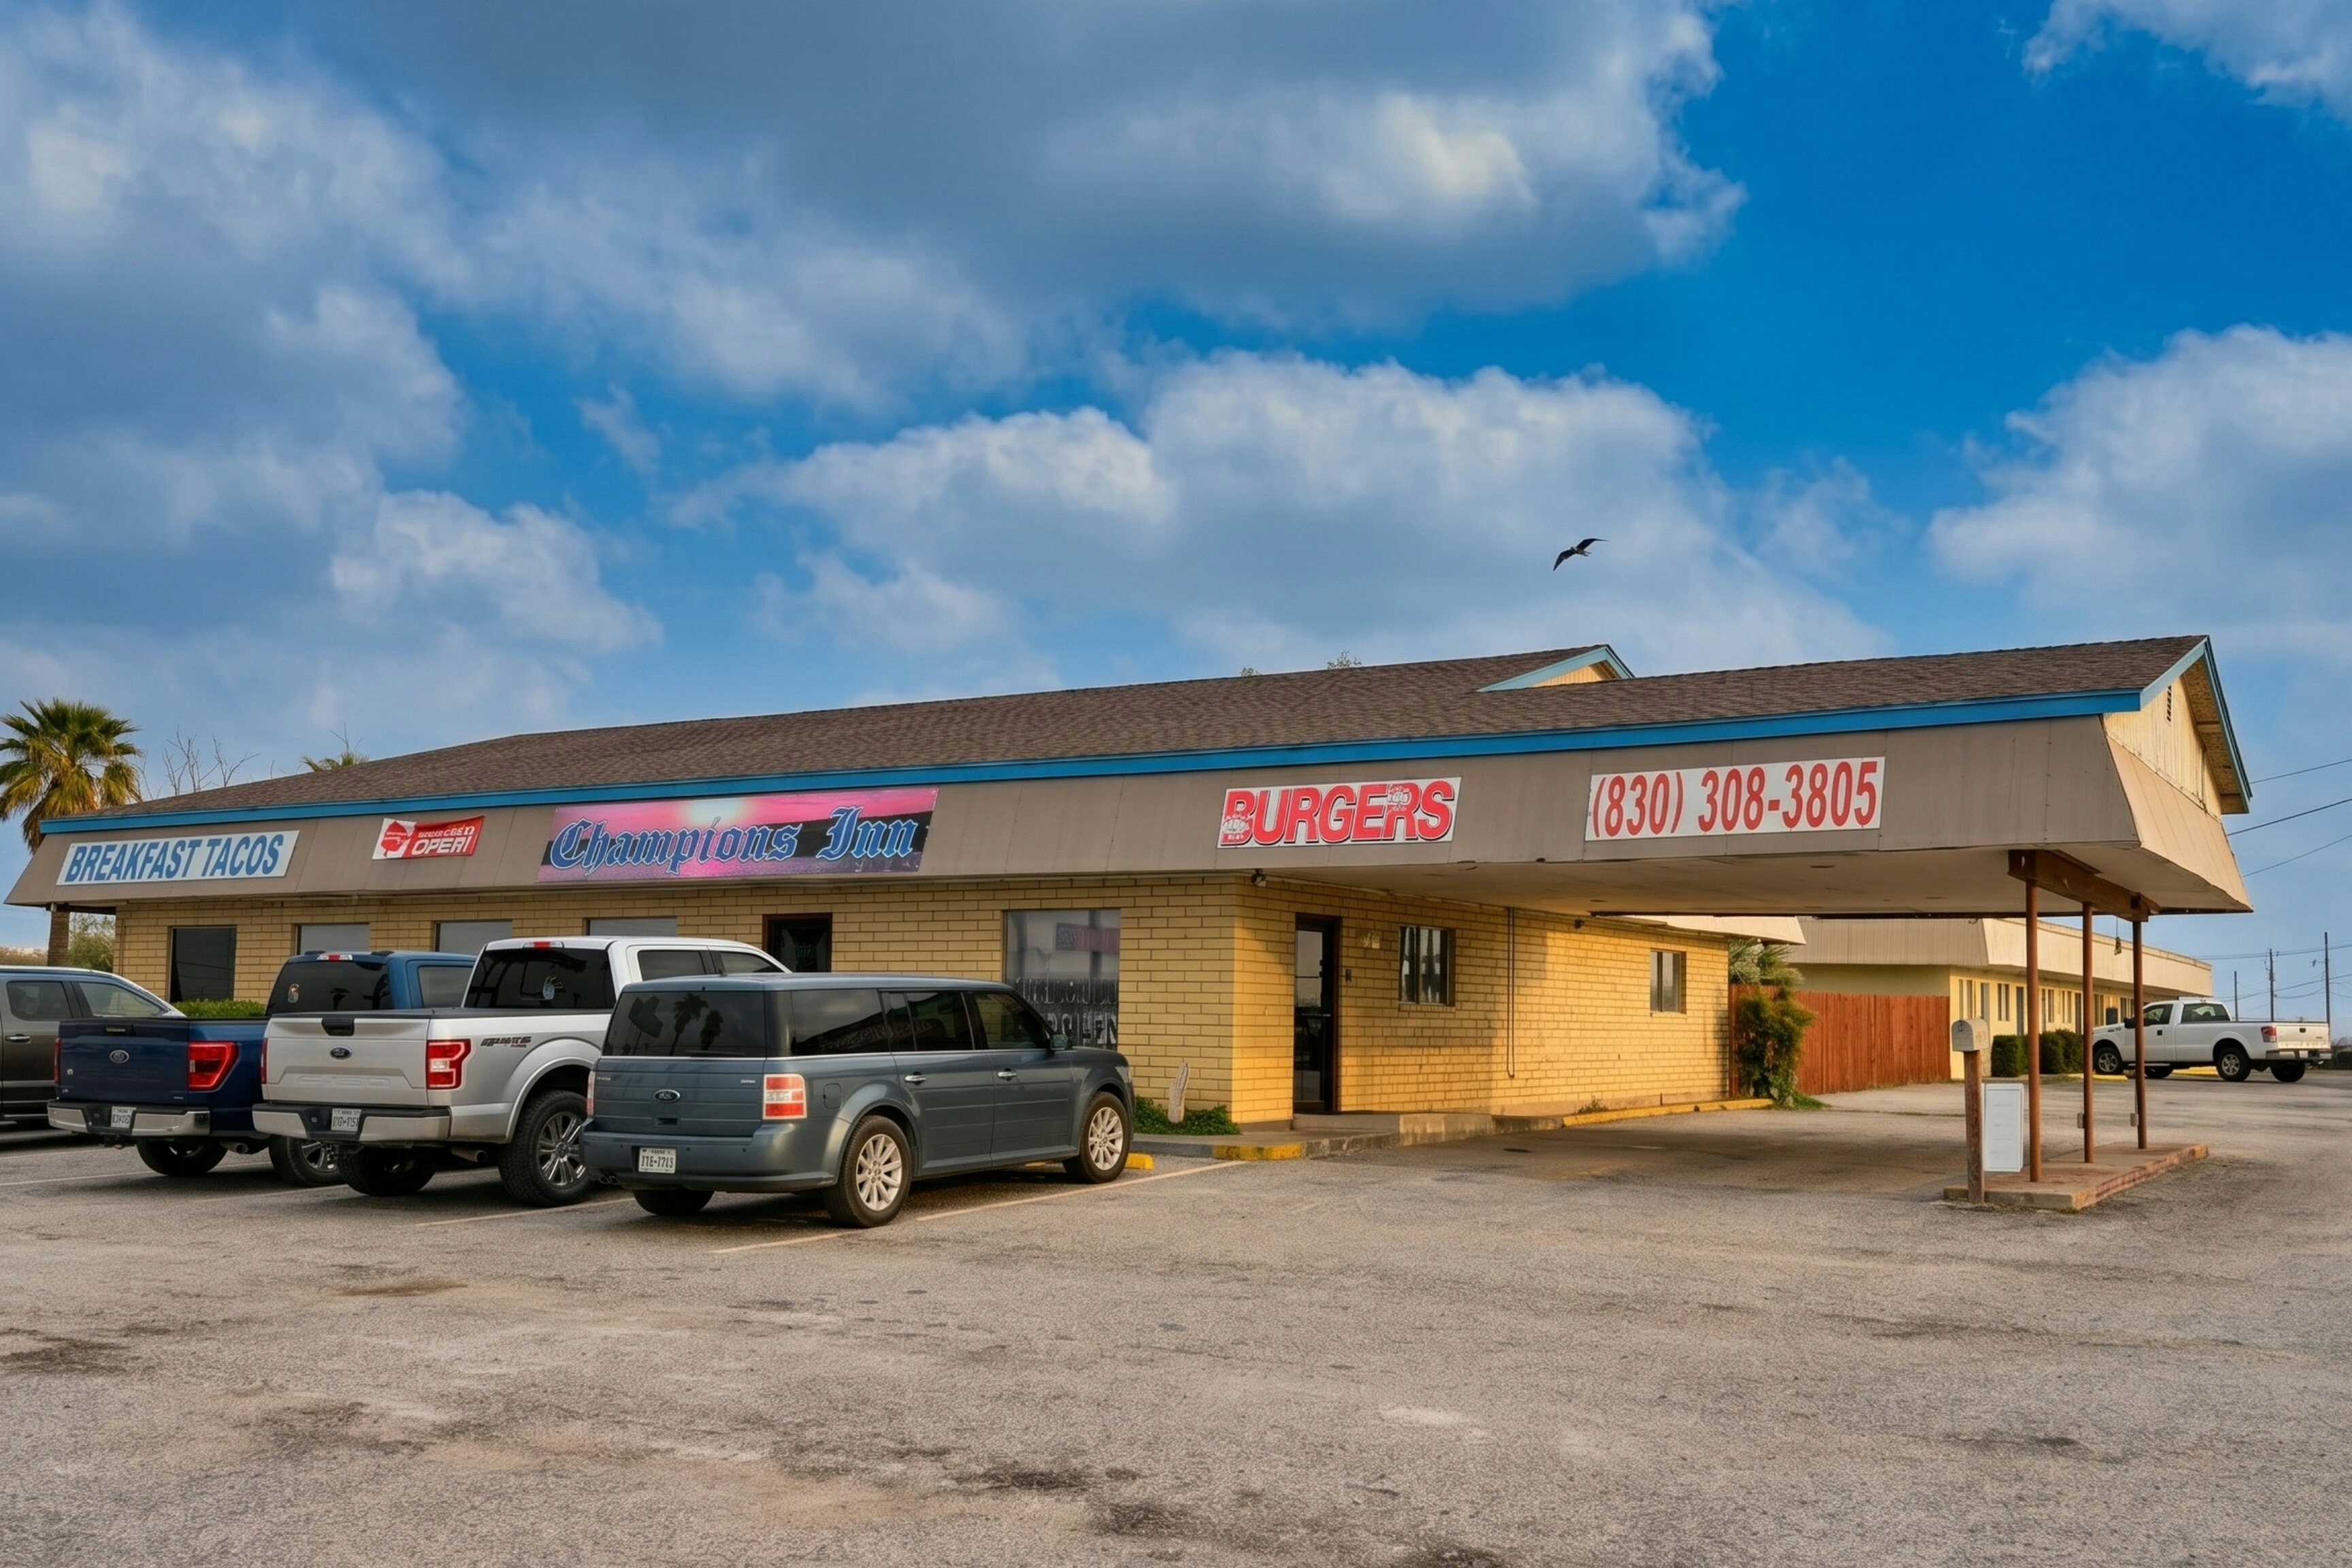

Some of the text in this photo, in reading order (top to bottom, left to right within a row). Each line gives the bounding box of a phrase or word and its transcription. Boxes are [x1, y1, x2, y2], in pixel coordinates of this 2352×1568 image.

[1220, 779, 1455, 847] BURGERS
[1592, 760, 1878, 838] (830) 308-3805
[64, 833, 284, 883] BREAKFAST TACOS
[550, 806, 919, 877] Champions Inn
